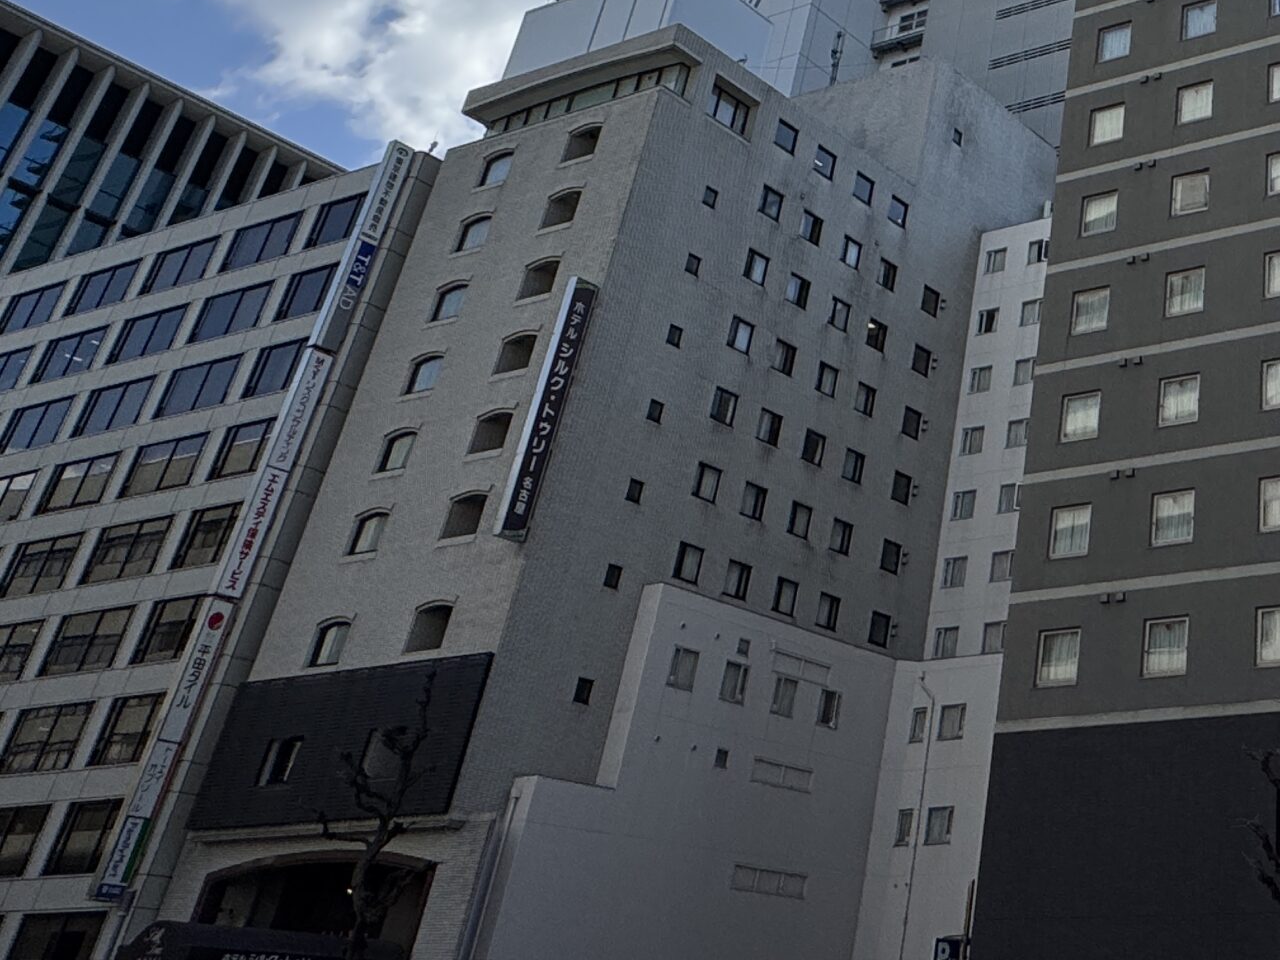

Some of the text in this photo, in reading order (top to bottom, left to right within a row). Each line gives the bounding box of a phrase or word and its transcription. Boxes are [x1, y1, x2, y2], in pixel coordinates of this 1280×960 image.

[565, 301, 586, 339] ホテル
[529, 342, 574, 472] シルク・トゥリー
[176, 643, 212, 709] 平田タイル
